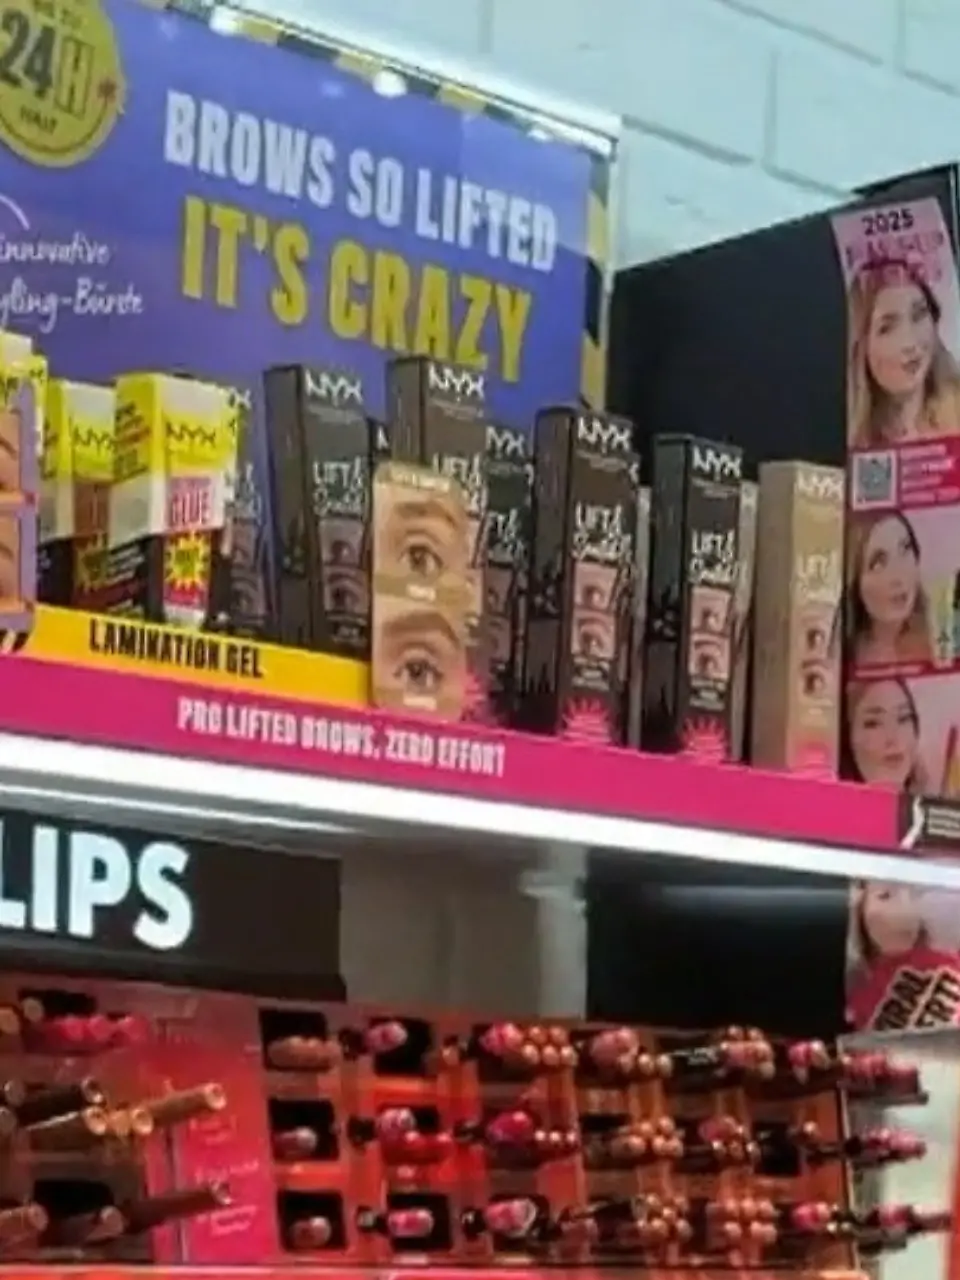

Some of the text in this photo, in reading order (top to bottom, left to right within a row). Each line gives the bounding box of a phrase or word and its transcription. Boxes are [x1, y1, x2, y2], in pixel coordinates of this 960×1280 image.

[164, 91, 557, 273] BROWS SO LIFTED
[862, 208, 914, 236] 2025
[182, 196, 532, 383] IT'S CRAZY
[303, 369, 362, 404] NYX
[428, 363, 485, 400] NYX
[165, 421, 217, 448] NYX
[578, 417, 632, 453] NYX
[693, 446, 741, 481] NYX
[89, 617, 263, 680] LAMINATION GEL
[178, 696, 221, 734] PRO
[227, 705, 296, 745] LIFTED
[385, 730, 433, 766] ZERO
[438, 737, 506, 778] EFFORT
